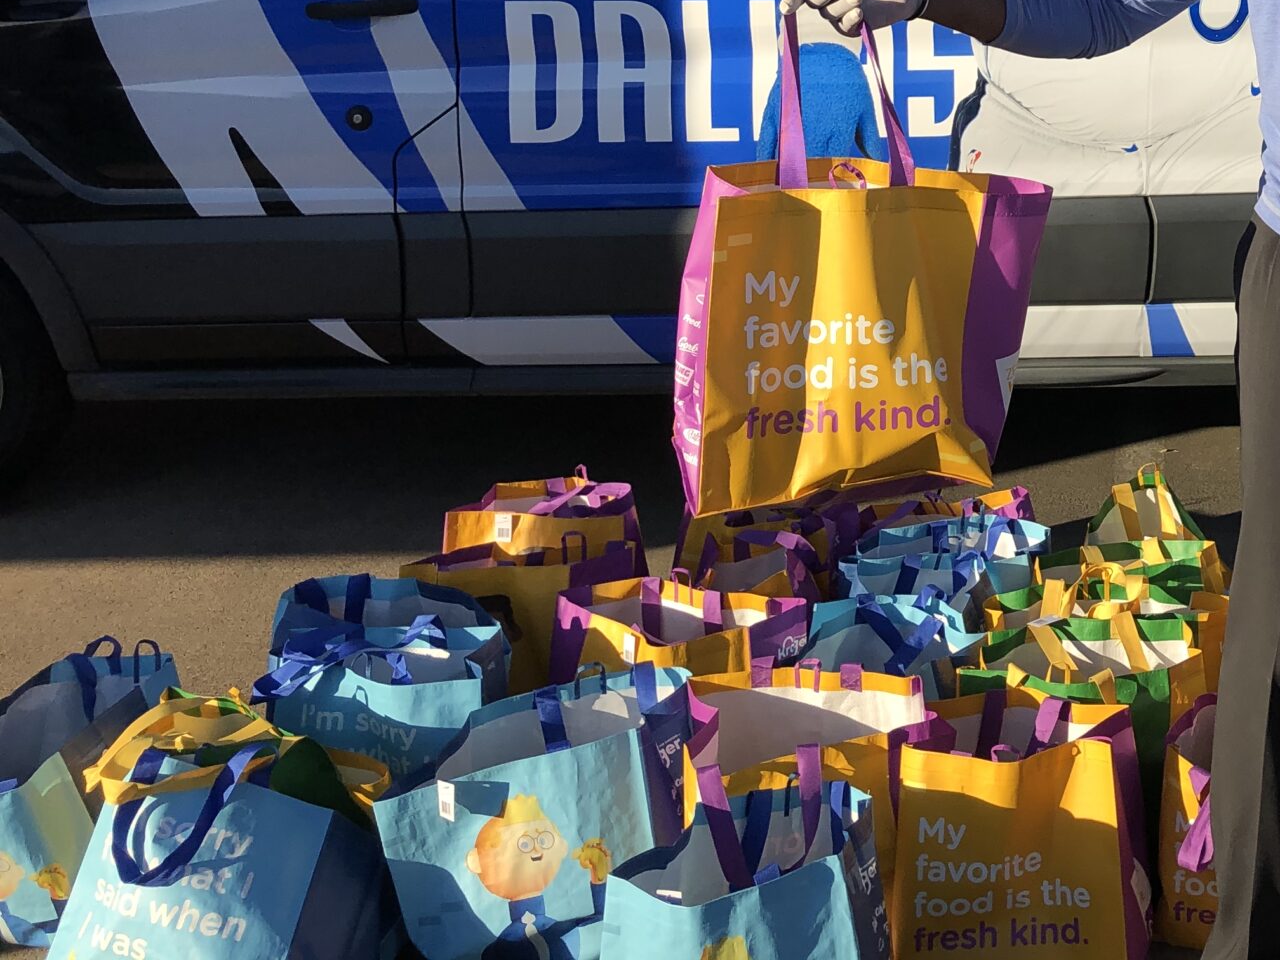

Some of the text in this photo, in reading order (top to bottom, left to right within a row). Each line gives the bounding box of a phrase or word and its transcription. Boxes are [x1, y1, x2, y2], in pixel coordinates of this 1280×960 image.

[504, 0, 976, 145] DALLS
[744, 270, 801, 308] My
[743, 313, 896, 350] favorite
[744, 352, 948, 395] food is the
[744, 402, 839, 440] fresh
[854, 395, 952, 433] kind.
[301, 703, 418, 752] I'm sorry
[918, 816, 967, 850] My
[915, 851, 1042, 884] favorite
[95, 878, 247, 942] said when
[913, 890, 994, 919] food
[1006, 888, 1031, 911] is
[1040, 878, 1091, 909] the
[1173, 901, 1217, 926] fre
[77, 911, 149, 960] I was
[913, 916, 1090, 953] fresh kind.
